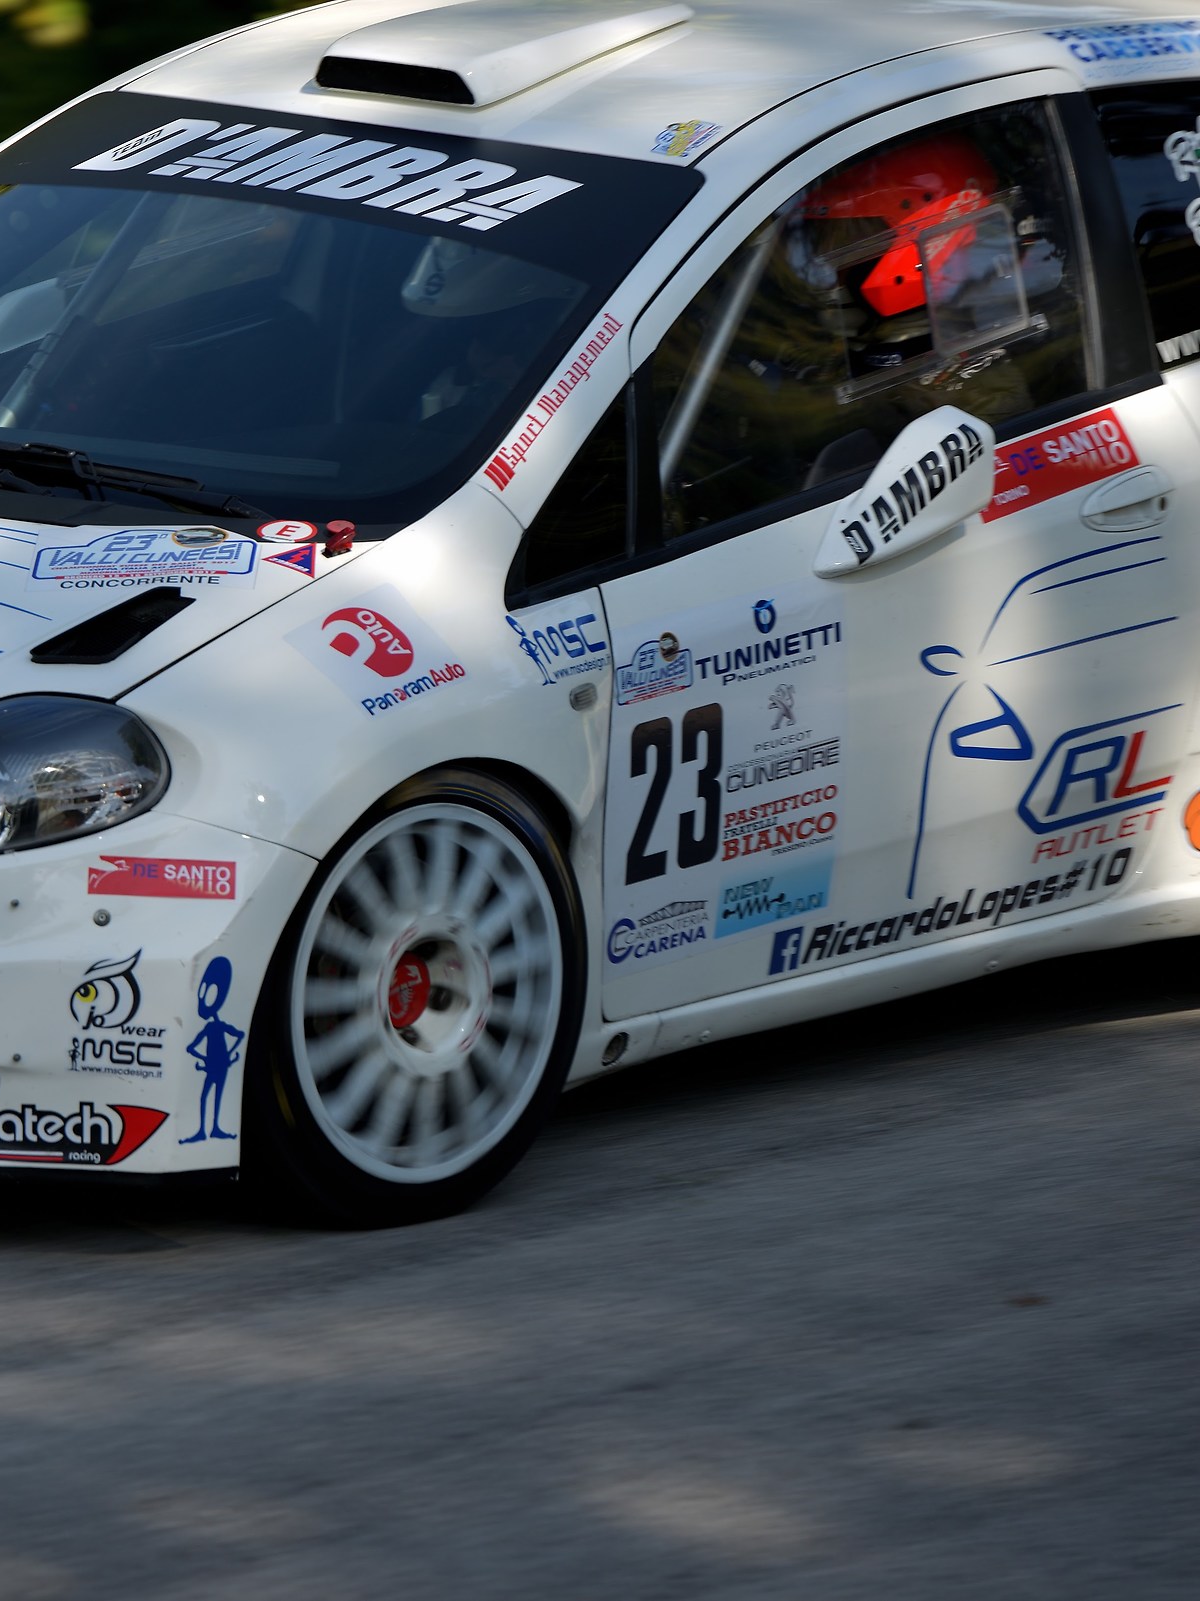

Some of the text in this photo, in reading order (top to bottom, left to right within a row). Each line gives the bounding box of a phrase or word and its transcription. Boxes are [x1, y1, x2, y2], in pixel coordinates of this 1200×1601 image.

[71, 118, 584, 231] D'AMBRA
[1009, 420, 1120, 476] DE SANTO
[842, 423, 984, 565] D'AMBRA
[276, 525, 301, 537] E
[49, 542, 243, 567] VALLI CUNEESI
[60, 575, 220, 589] CONCORRENTE
[695, 621, 841, 679] TUNINETTI
[754, 729, 813, 752] PEUGEOT
[625, 702, 723, 886] 23
[724, 784, 837, 828] PASTIFICIO
[721, 811, 837, 862] BIANCO
[1031, 807, 1166, 864] AUTLET
[132, 863, 231, 881] DE SANTO
[801, 847, 1133, 965] RiccardoLopes#10
[634, 925, 706, 958] CARENA
[120, 1024, 167, 1038] wear
[81, 1065, 163, 1079] www.mscdesign.it
[68, 1149, 101, 1164] racing
